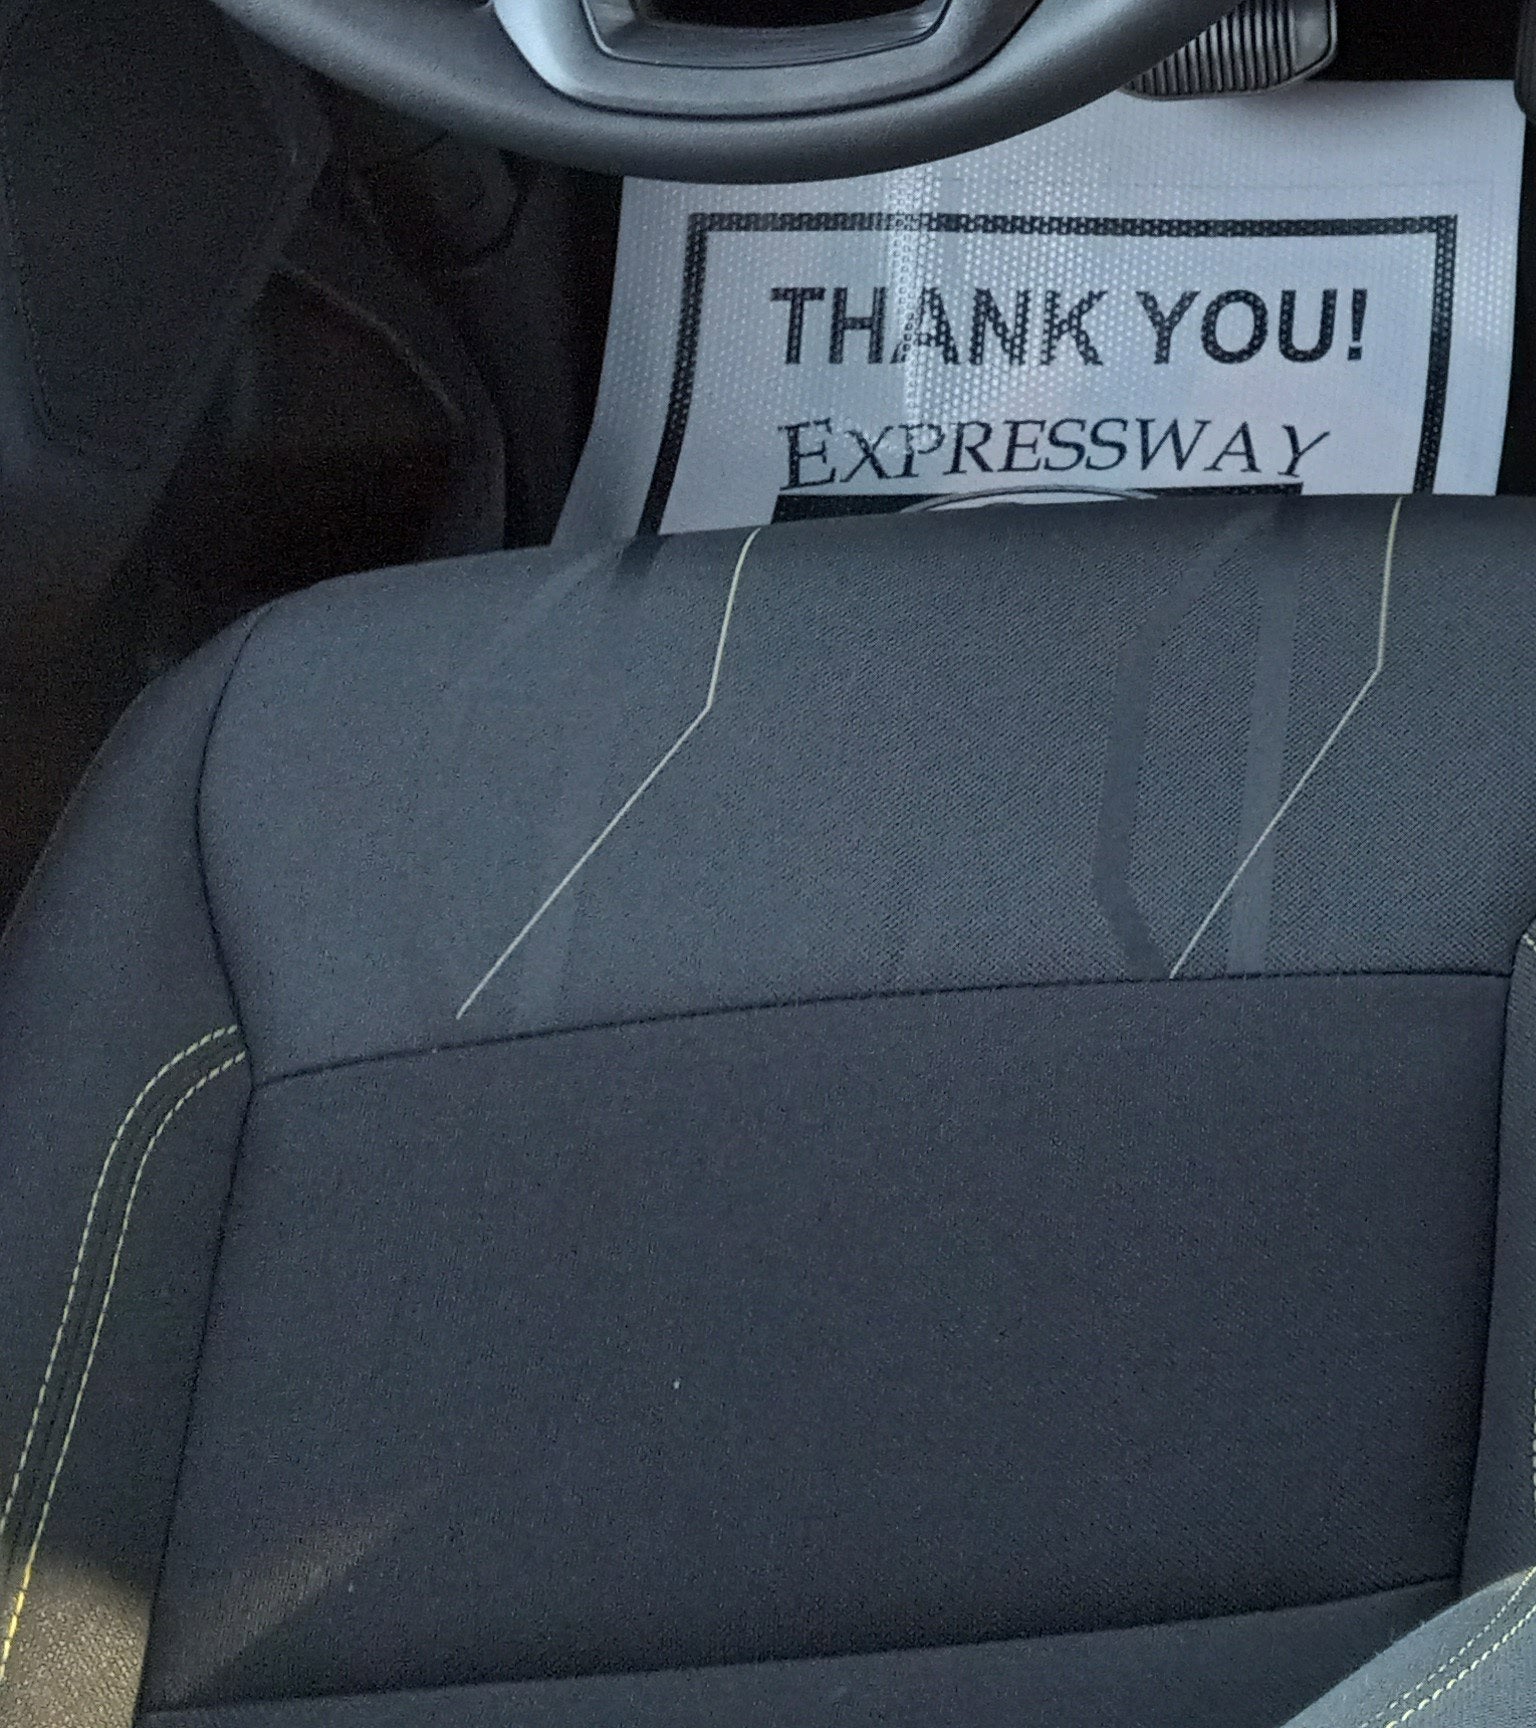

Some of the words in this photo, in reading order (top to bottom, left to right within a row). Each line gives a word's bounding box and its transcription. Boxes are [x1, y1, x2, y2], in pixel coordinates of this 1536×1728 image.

[769, 286, 1107, 366] THANK
[1137, 286, 1369, 365] YOU!
[776, 416, 1333, 491] EXPRESSWAY
